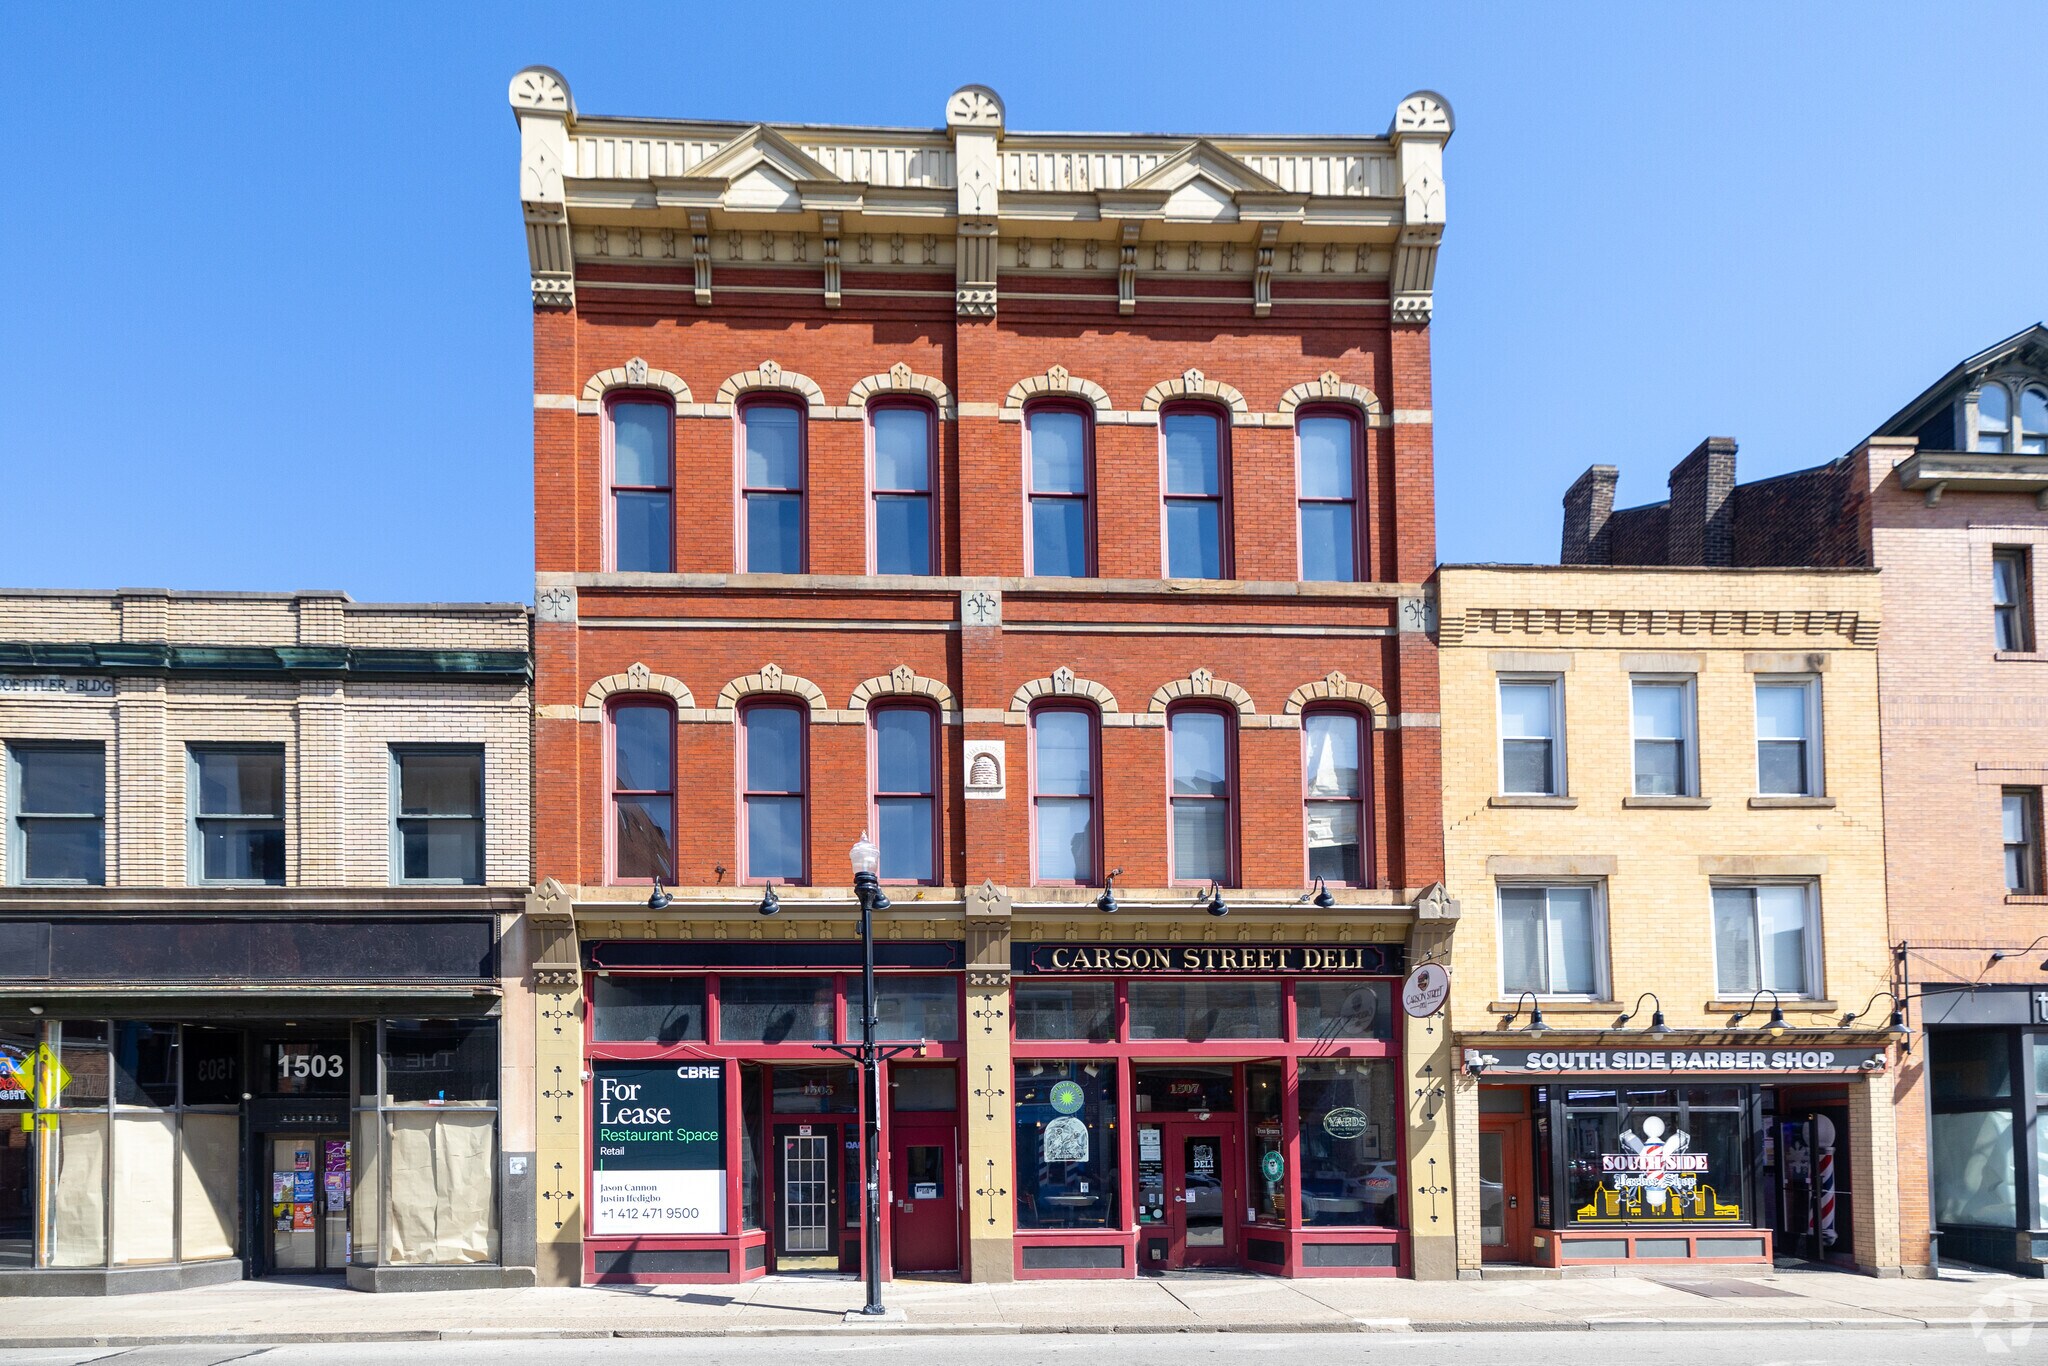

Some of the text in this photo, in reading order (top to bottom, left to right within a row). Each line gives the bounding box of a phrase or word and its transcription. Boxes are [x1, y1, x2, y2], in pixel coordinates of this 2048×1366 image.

[76, 680, 112, 692] BLDG
[1052, 948, 1365, 969] CARSON STREET DELI
[1406, 984, 1444, 1006] CARSON STREET
[278, 1055, 344, 1078] 1503
[1525, 1052, 1835, 1070] SOUTH SIDE BARBER SHOP
[677, 1066, 720, 1079] CBRE
[600, 1078, 641, 1101] For
[1170, 1083, 1200, 1094] 1507
[600, 1102, 671, 1125] Lease
[1328, 1116, 1366, 1127] YARDS
[600, 1128, 719, 1144] Restaurant Space
[600, 1146, 625, 1156] Retail
[1194, 1160, 1214, 1168] DELI
[1603, 1155, 1708, 1171] SOUTH SIDE
[600, 1184, 657, 1193] Jason Cannon
[1614, 1173, 1697, 1190] Barber Shop
[600, 1194, 661, 1204] Justin Ifedigbo
[601, 1207, 699, 1219] +1 412 471 9500
